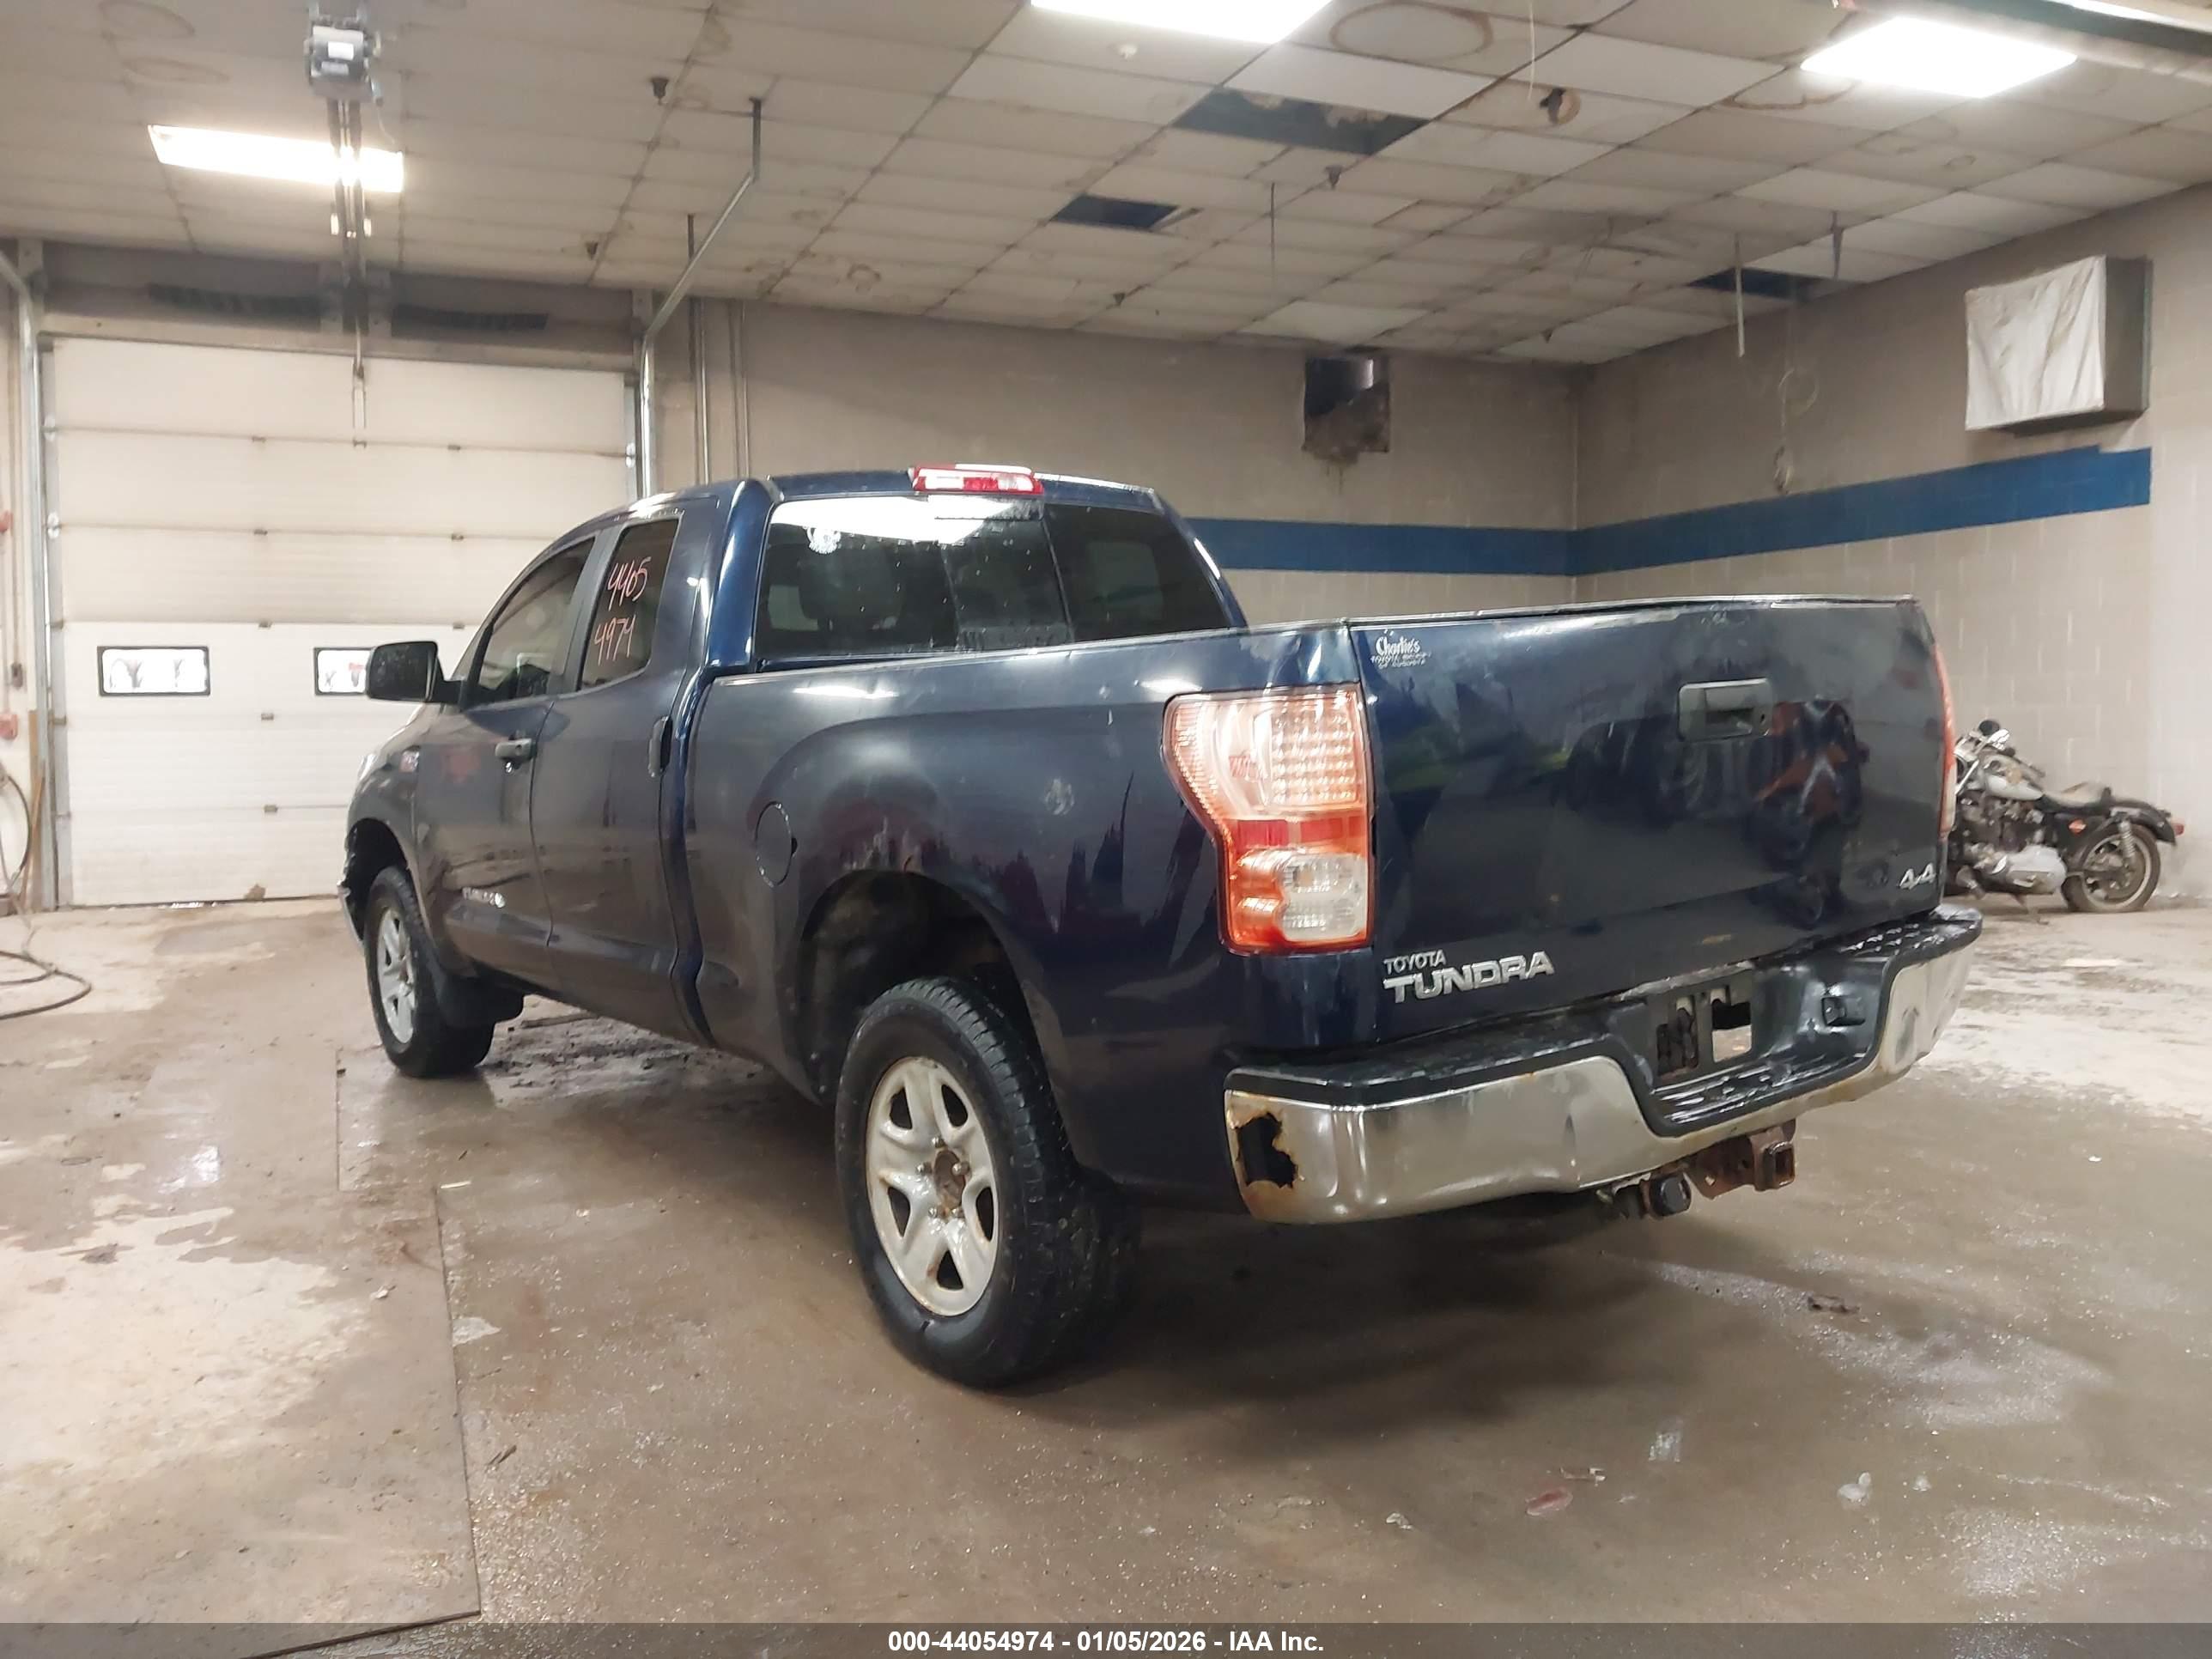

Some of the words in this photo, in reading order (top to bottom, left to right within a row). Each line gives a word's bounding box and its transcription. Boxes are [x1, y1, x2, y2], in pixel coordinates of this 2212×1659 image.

[593, 614, 636, 665] 4974
[1375, 635, 1421, 657] Charlie's
[1382, 951, 1554, 1003] TUNDRA
[1383, 949, 1447, 975] TOYOTA
